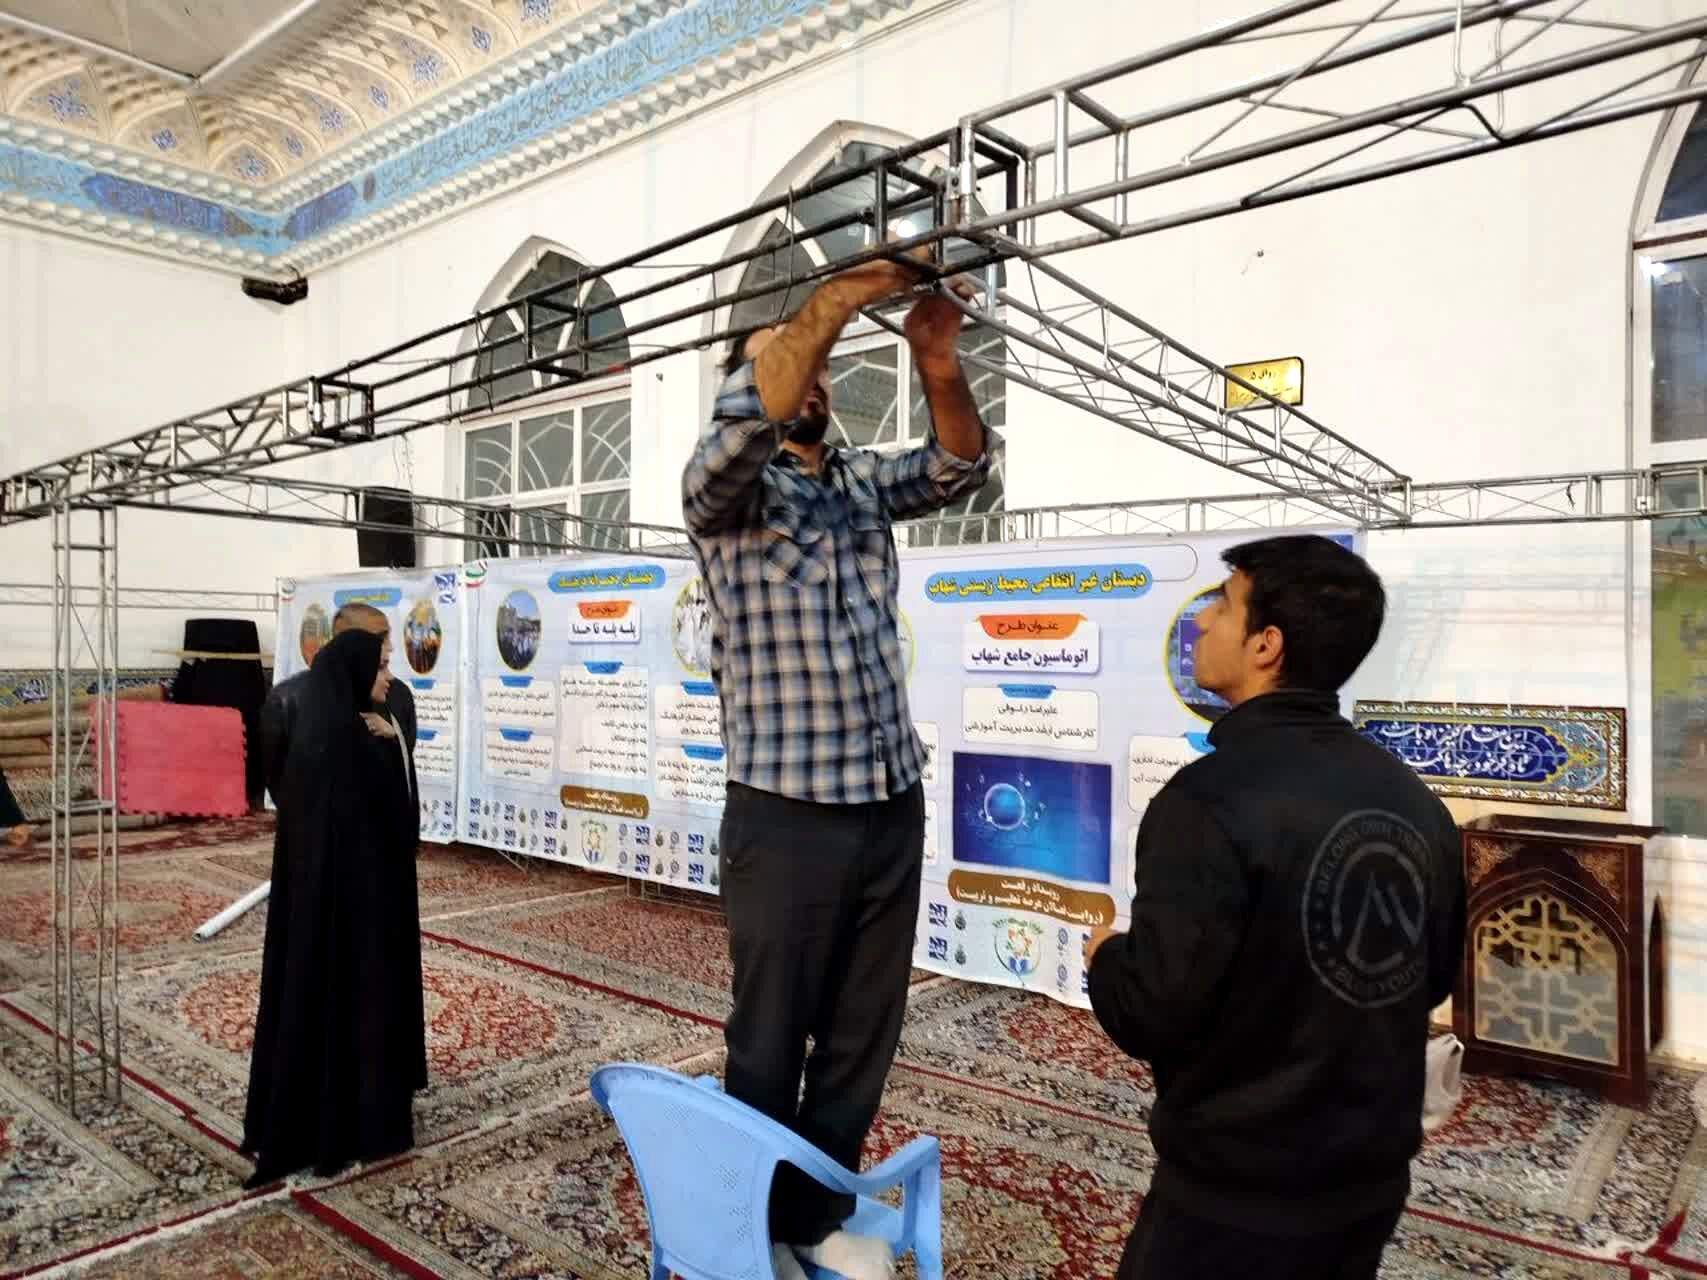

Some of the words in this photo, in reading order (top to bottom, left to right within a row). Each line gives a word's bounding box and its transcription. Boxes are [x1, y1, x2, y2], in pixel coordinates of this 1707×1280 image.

[928, 577, 957, 596] شهاب
[959, 579, 994, 596] زیستی
[998, 574, 1029, 592] محیط
[1031, 571, 1075, 593] انتفاعی
[1078, 574, 1099, 593] غیر
[1101, 569, 1147, 592] دبستان
[996, 620, 1026, 636] طرح
[1028, 621, 1060, 633] عنوان
[971, 647, 1001, 664] شهاب
[1004, 648, 1033, 666] جامع
[1034, 649, 1089, 667] اتوماسیون
[1000, 723, 1034, 735] مدیریت
[1036, 726, 1053, 737] ارشد
[1053, 728, 1097, 740] کارشناس
